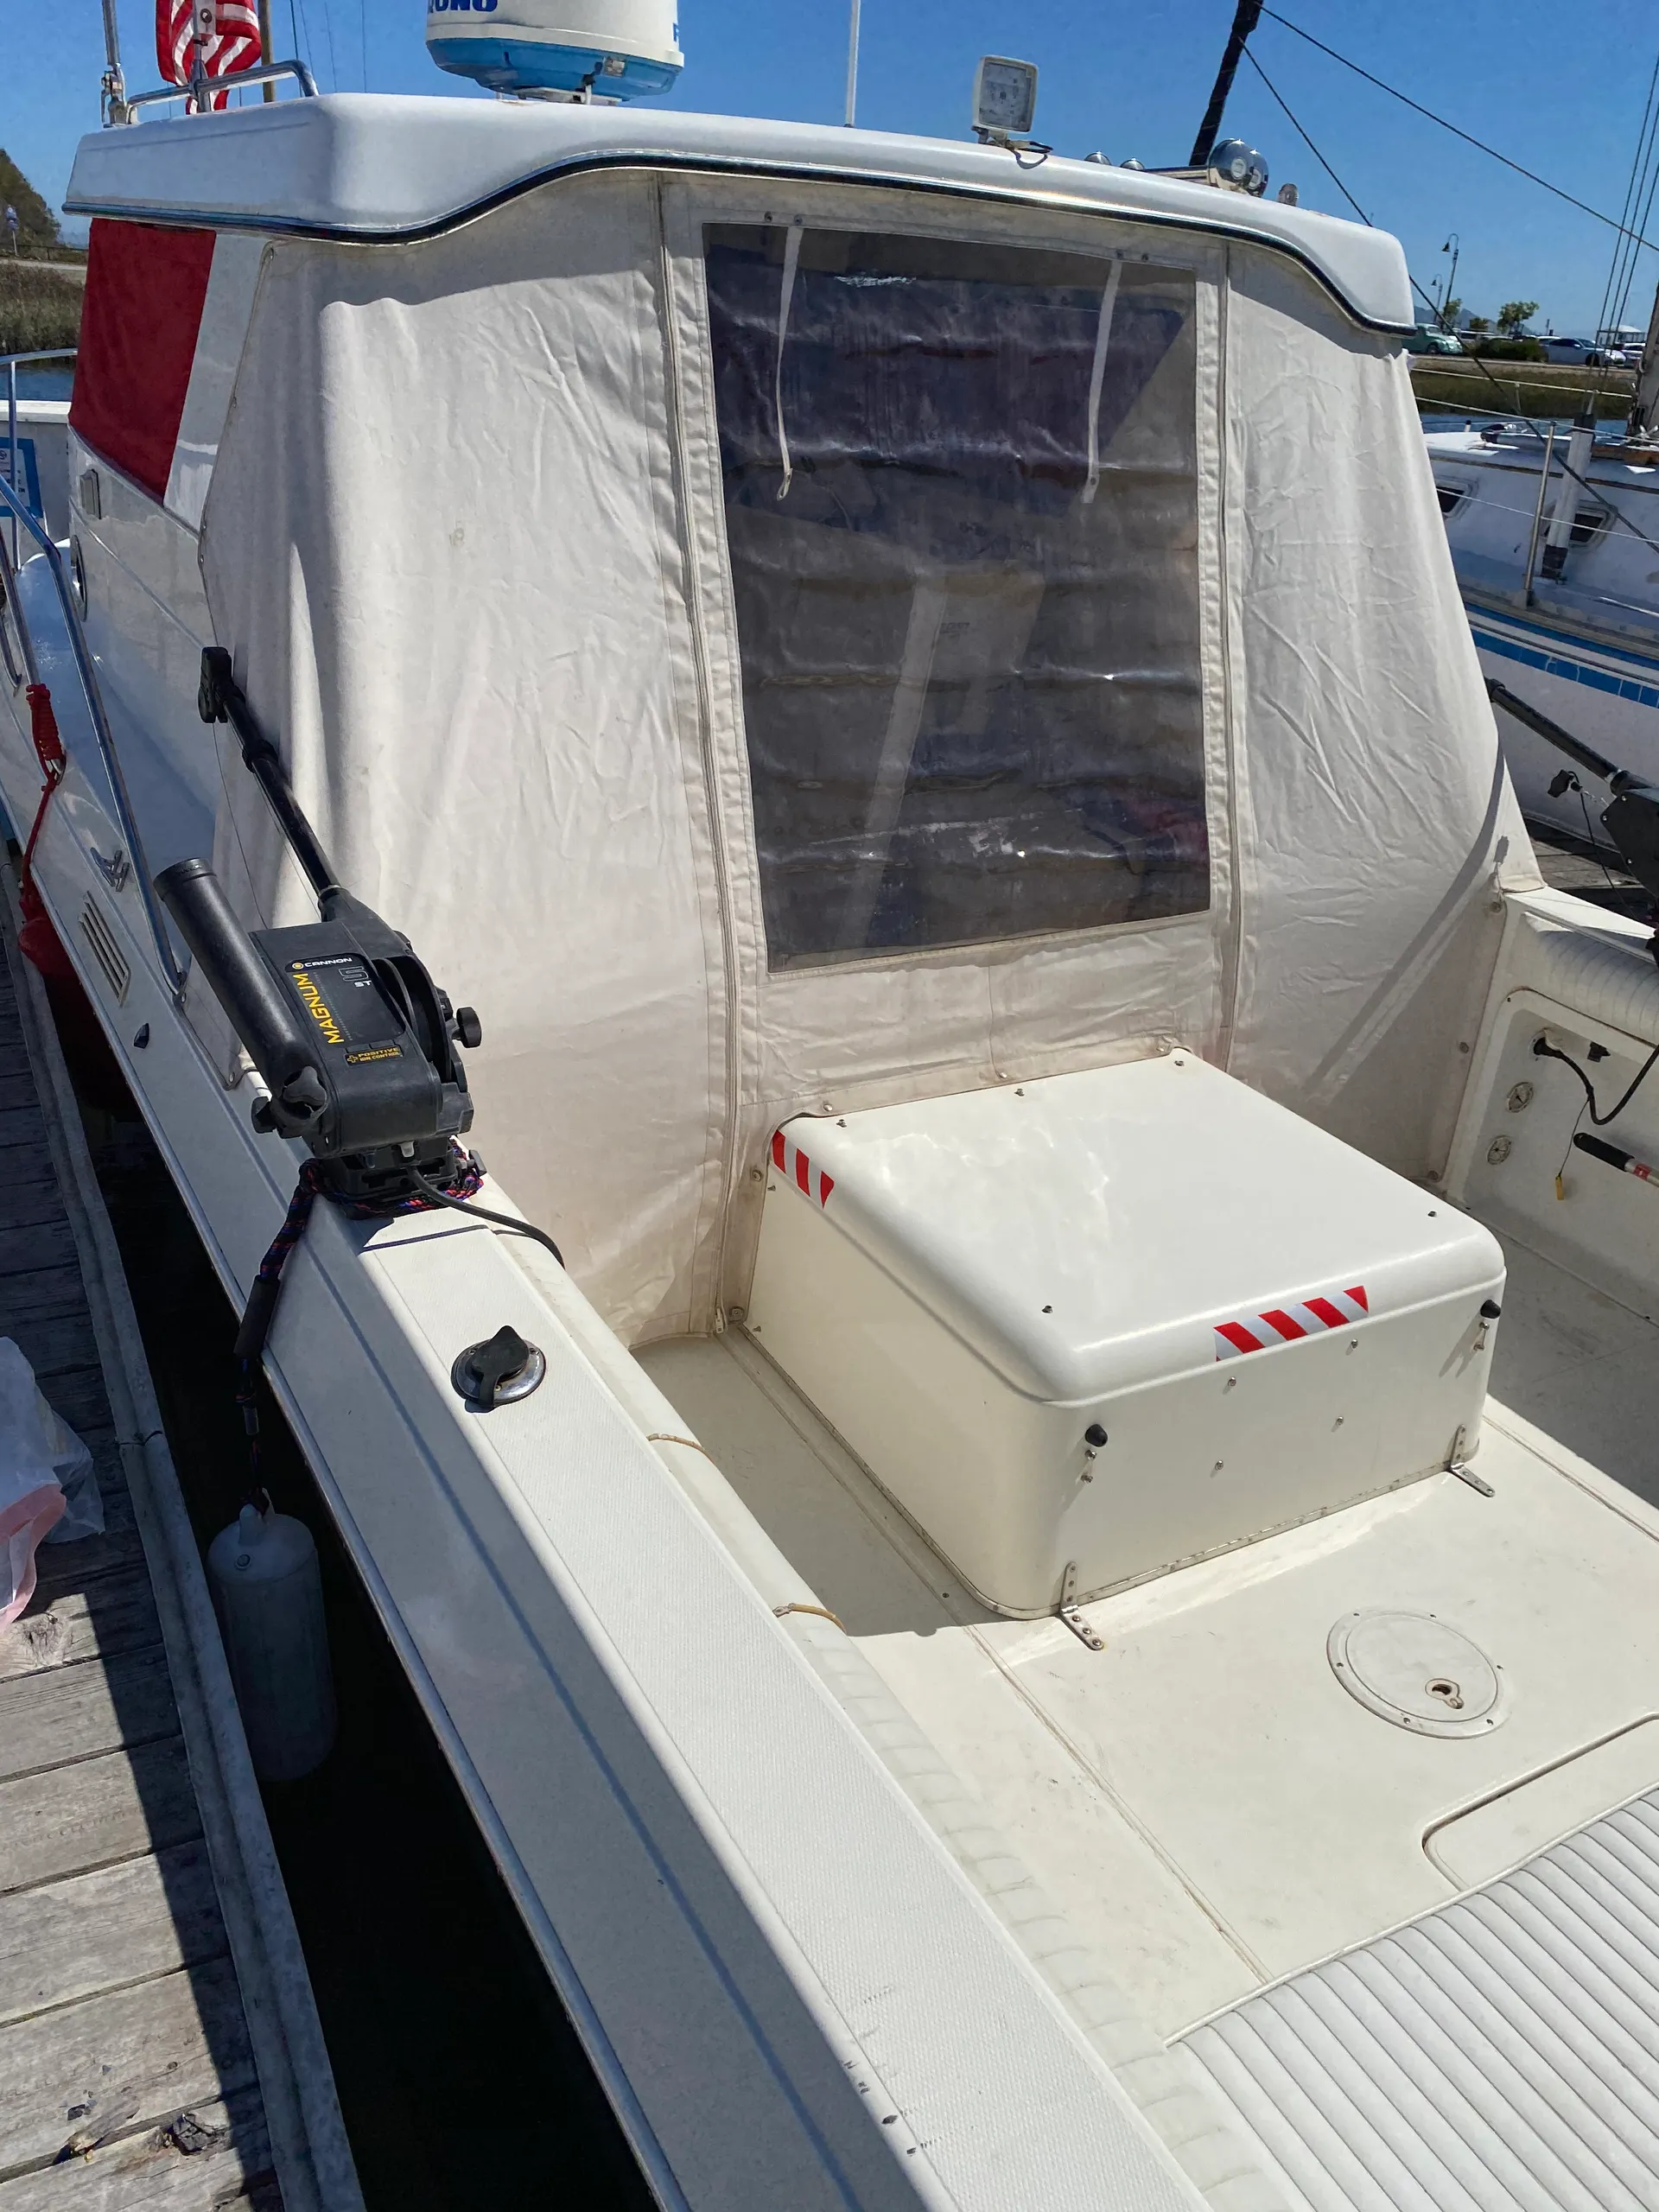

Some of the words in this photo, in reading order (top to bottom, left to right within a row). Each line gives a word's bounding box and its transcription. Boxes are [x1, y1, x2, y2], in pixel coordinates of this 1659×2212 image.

[304, 957, 353, 968] CANNON
[292, 973, 345, 1044] MAGNUM
[358, 1046, 399, 1058] POSITIVE
